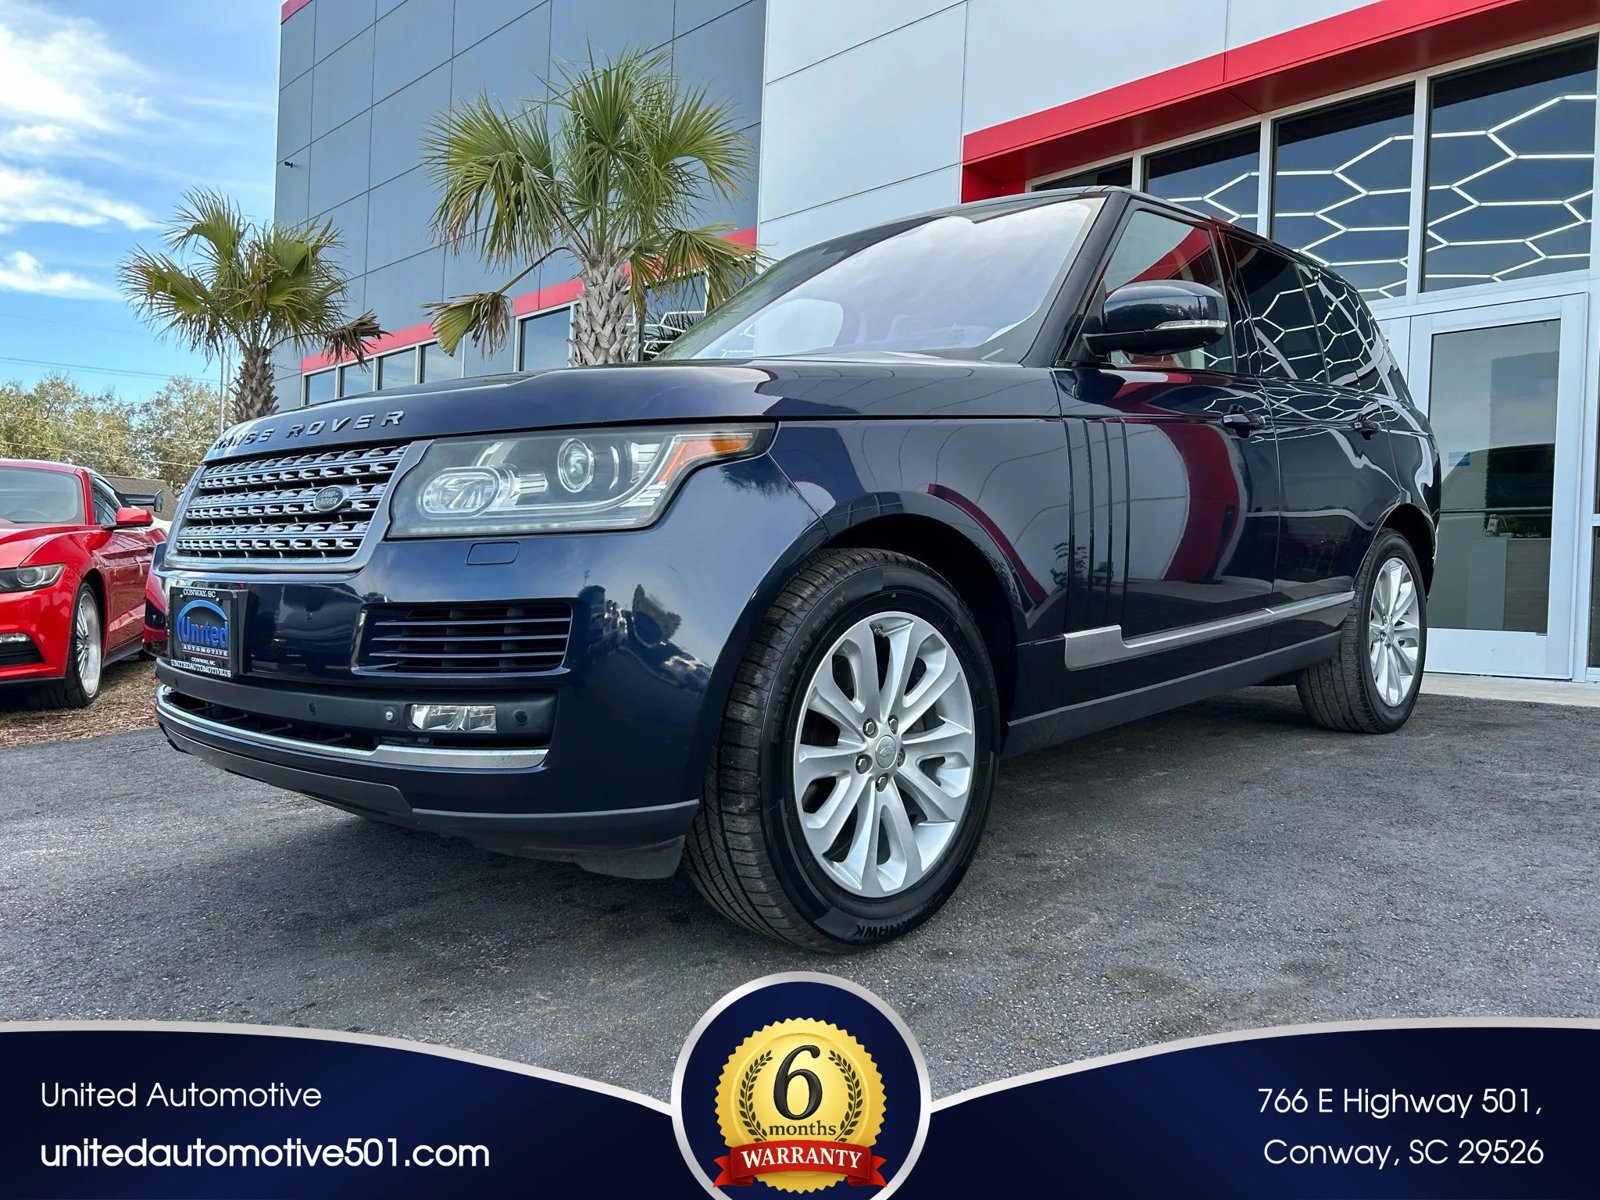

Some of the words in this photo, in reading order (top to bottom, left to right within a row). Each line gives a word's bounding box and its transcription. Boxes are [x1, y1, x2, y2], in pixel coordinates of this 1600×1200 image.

[214, 428, 276, 450] RANGE
[286, 410, 405, 439] ROVER
[181, 616, 229, 648] United
[182, 643, 229, 656] AUTOMOTIVE
